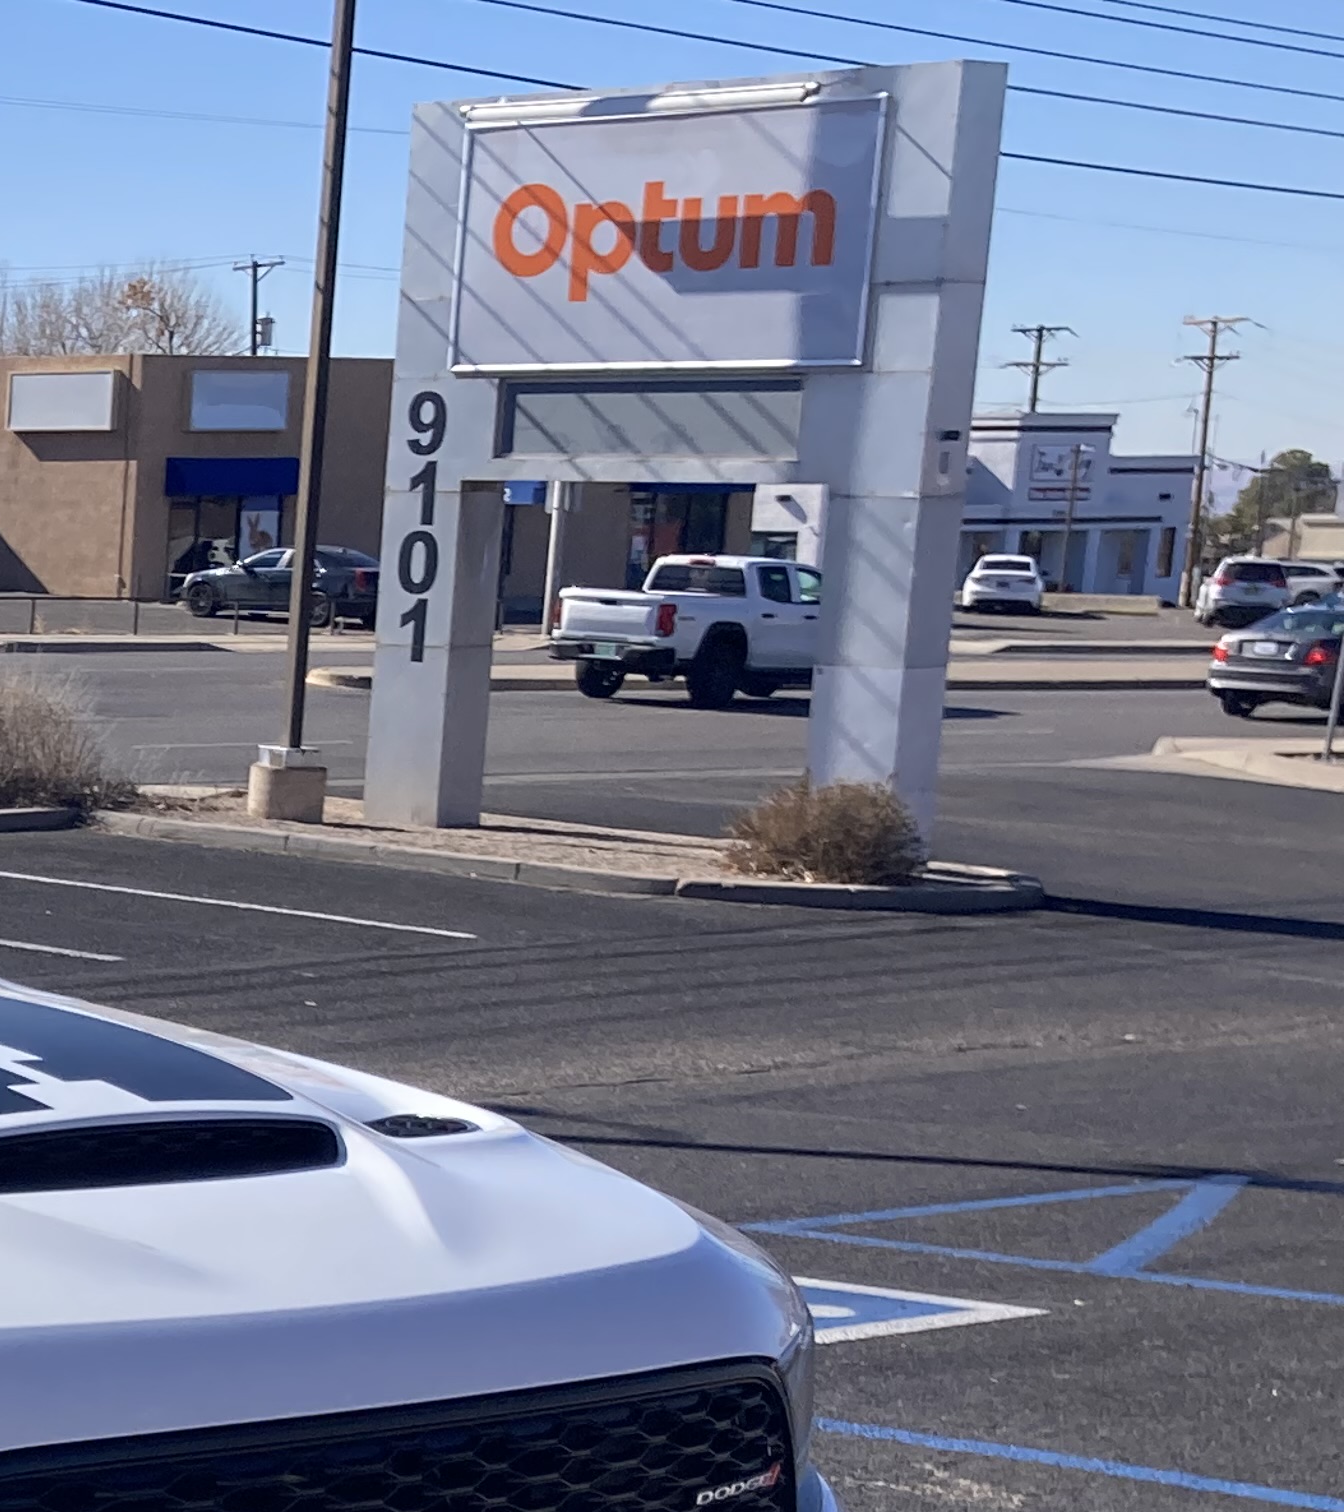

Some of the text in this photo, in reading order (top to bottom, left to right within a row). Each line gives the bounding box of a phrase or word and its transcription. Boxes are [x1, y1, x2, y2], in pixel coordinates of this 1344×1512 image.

[492, 181, 838, 302] Optum
[398, 391, 447, 663] 9101
[696, 1472, 774, 1505] DODGE
